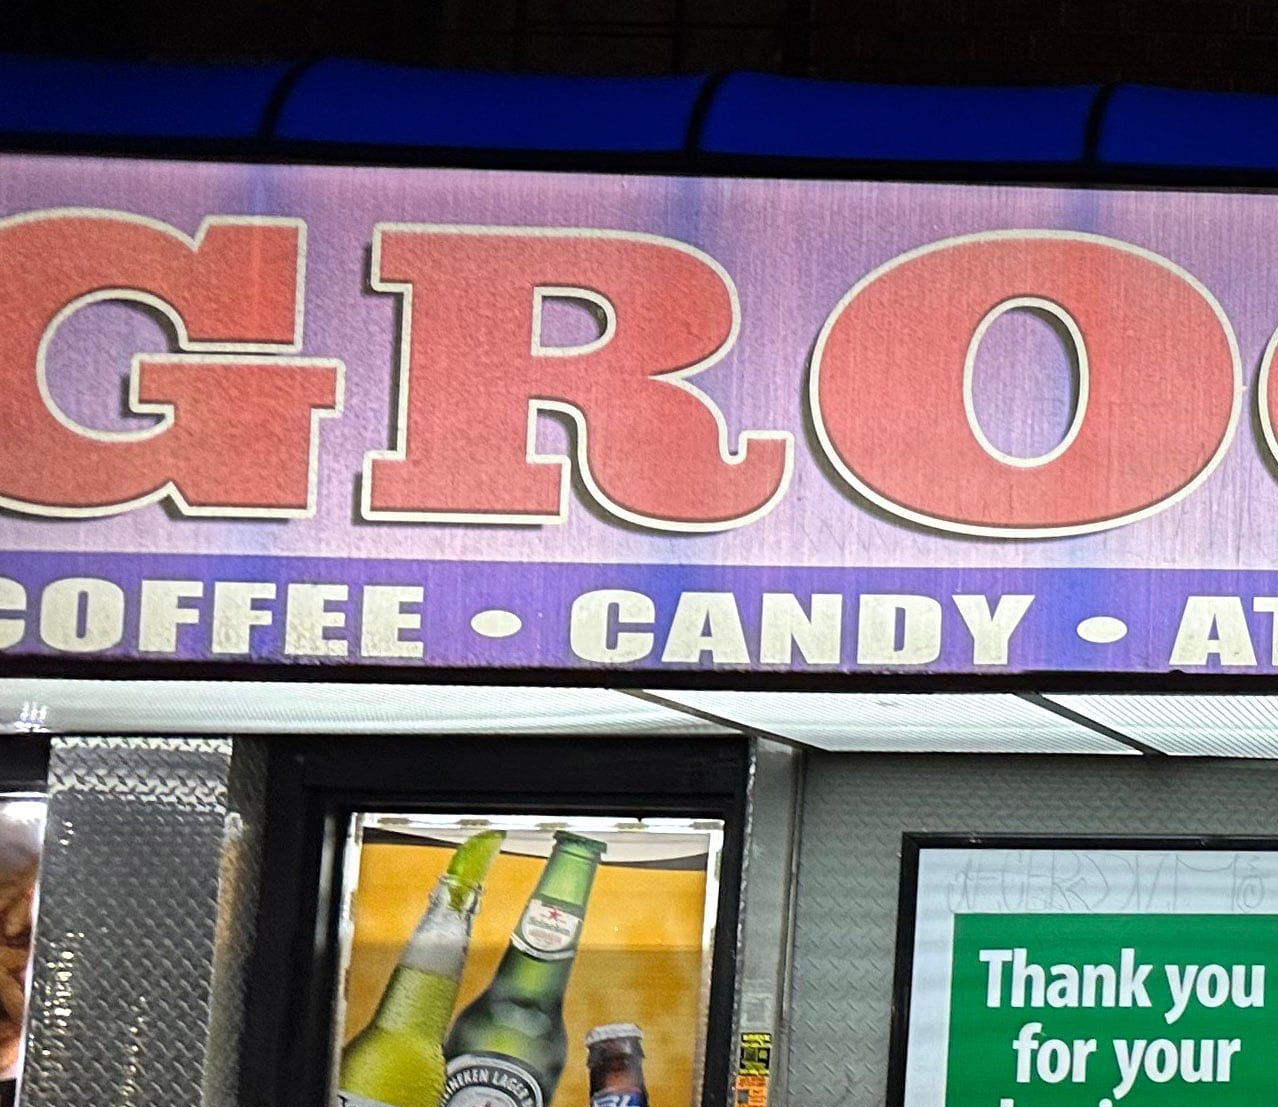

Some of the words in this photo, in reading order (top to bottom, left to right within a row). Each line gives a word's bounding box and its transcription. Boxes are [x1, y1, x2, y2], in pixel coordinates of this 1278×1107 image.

[569, 589, 1035, 666] CANDY
[979, 948, 1152, 1009] Thank
[1165, 965, 1265, 1024] you
[1013, 1022, 1096, 1083] for
[1112, 1037, 1241, 1099] your
